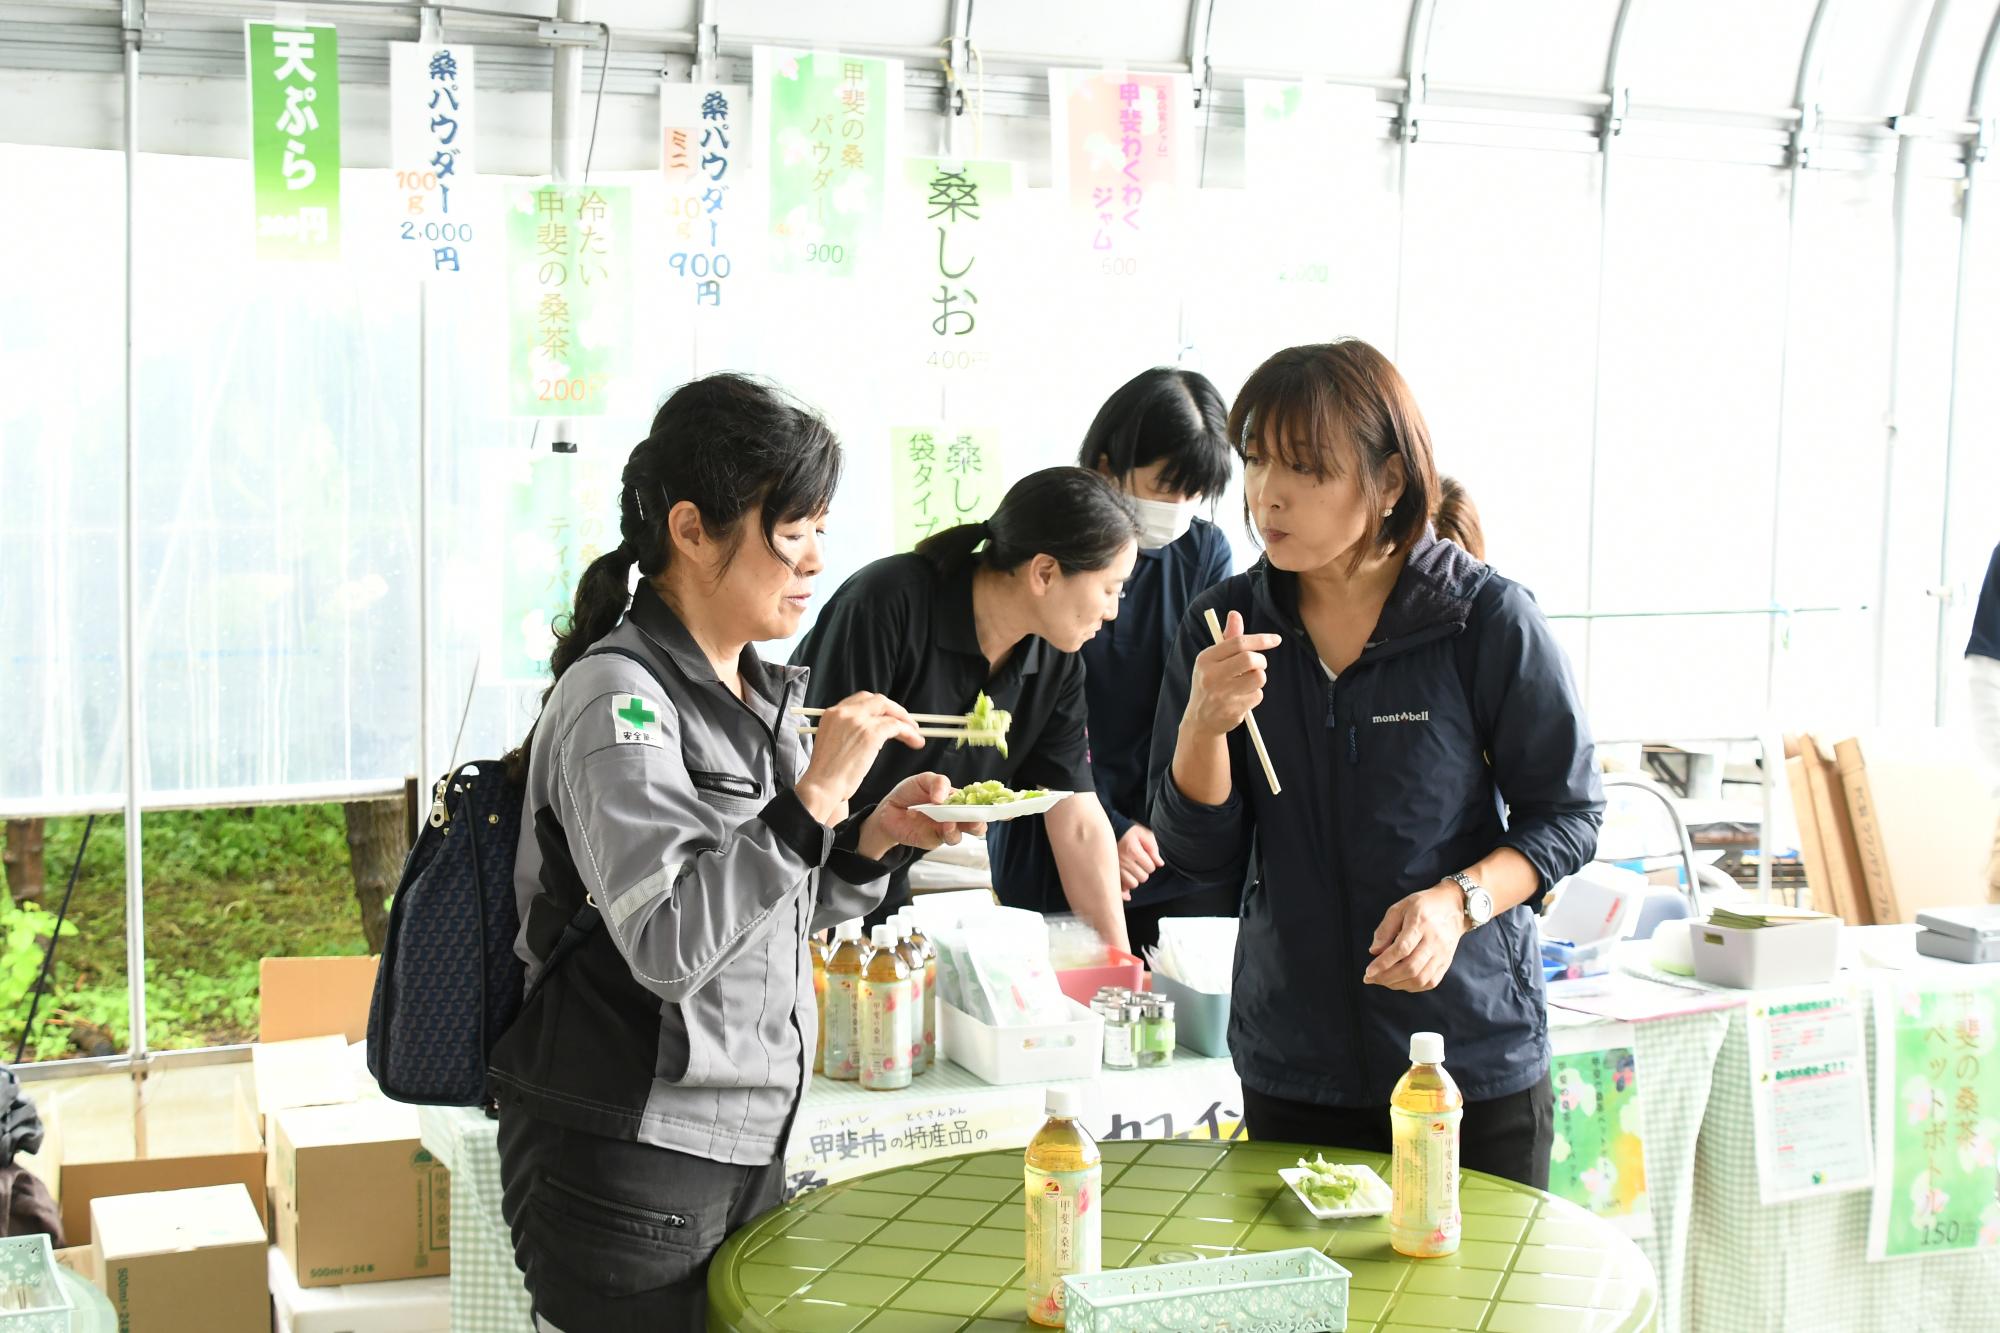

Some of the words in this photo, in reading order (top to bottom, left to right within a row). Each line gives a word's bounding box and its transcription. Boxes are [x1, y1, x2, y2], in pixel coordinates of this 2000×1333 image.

[273, 31, 319, 190] 天ぷら
[428, 49, 461, 214] 桑パウダー
[670, 130, 689, 168] ミニ
[841, 63, 865, 169] 甲斐の桑
[1120, 83, 1143, 230] 甲斐わくわく
[700, 90, 730, 247] 桑パウダー
[810, 114, 834, 220] パウダー
[1092, 186, 1114, 250] ジャム
[400, 221, 472, 242] 2,000
[536, 190, 570, 359] 甲斐の桑茶
[577, 190, 608, 287] 冷たい
[669, 253, 731, 278] 900
[927, 166, 980, 336] 桑しお
[810, 1120, 988, 1163] 甲斐市の特産品の
